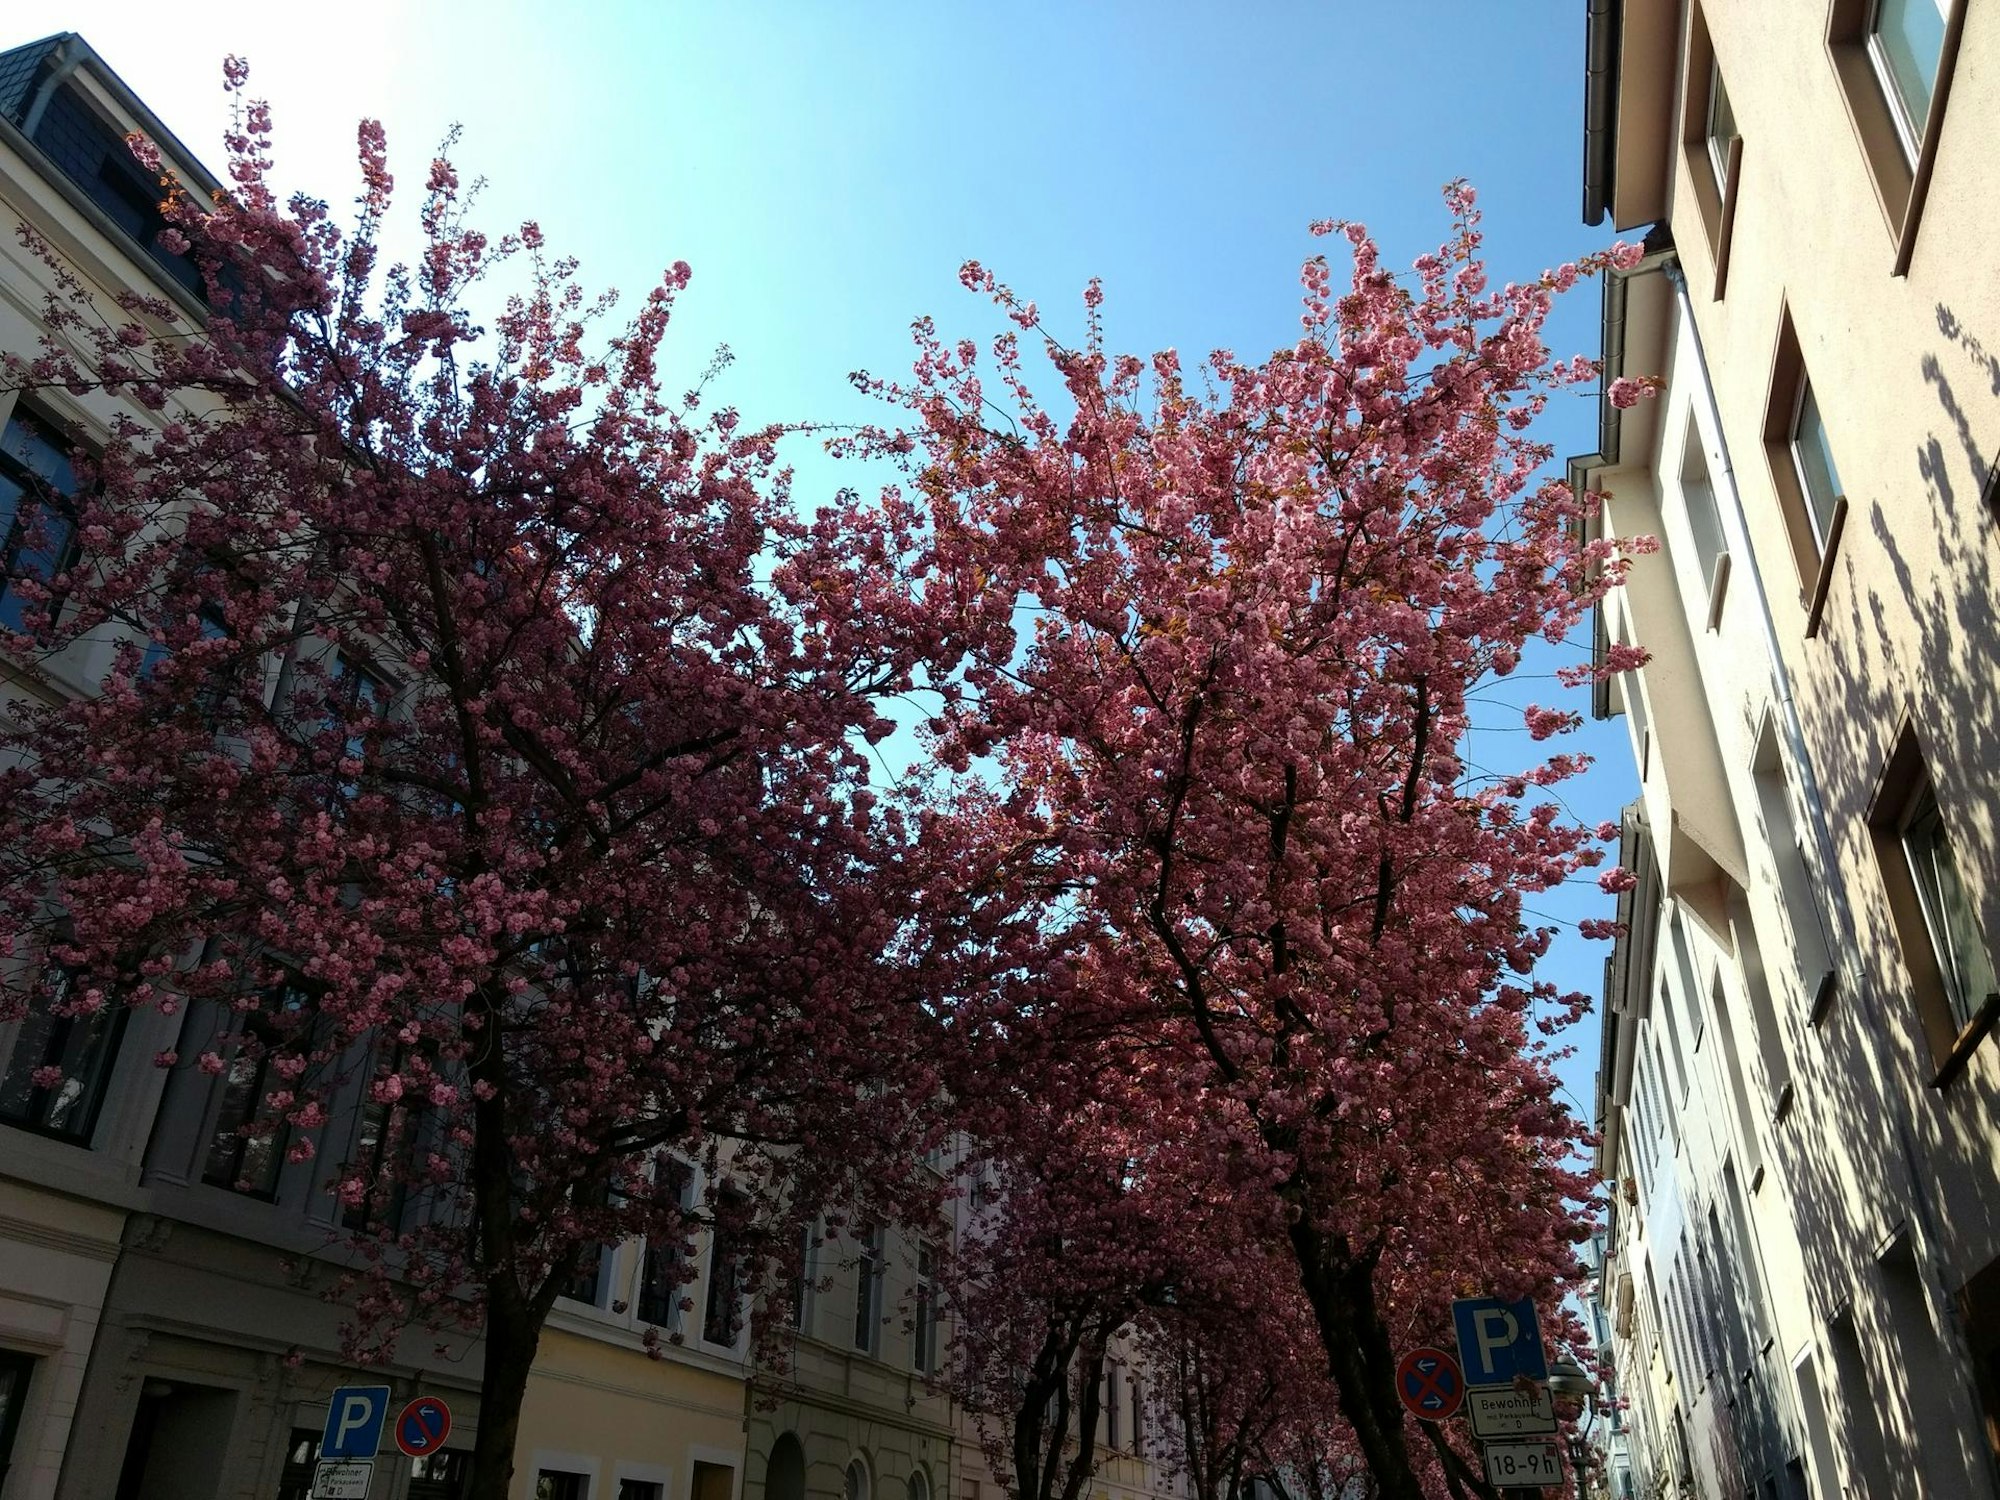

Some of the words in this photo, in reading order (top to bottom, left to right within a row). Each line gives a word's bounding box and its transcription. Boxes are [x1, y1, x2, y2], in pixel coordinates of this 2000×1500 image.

[1473, 1308, 1518, 1374] P
[335, 1396, 372, 1449] P
[1481, 1397, 1542, 1410] Bewohner
